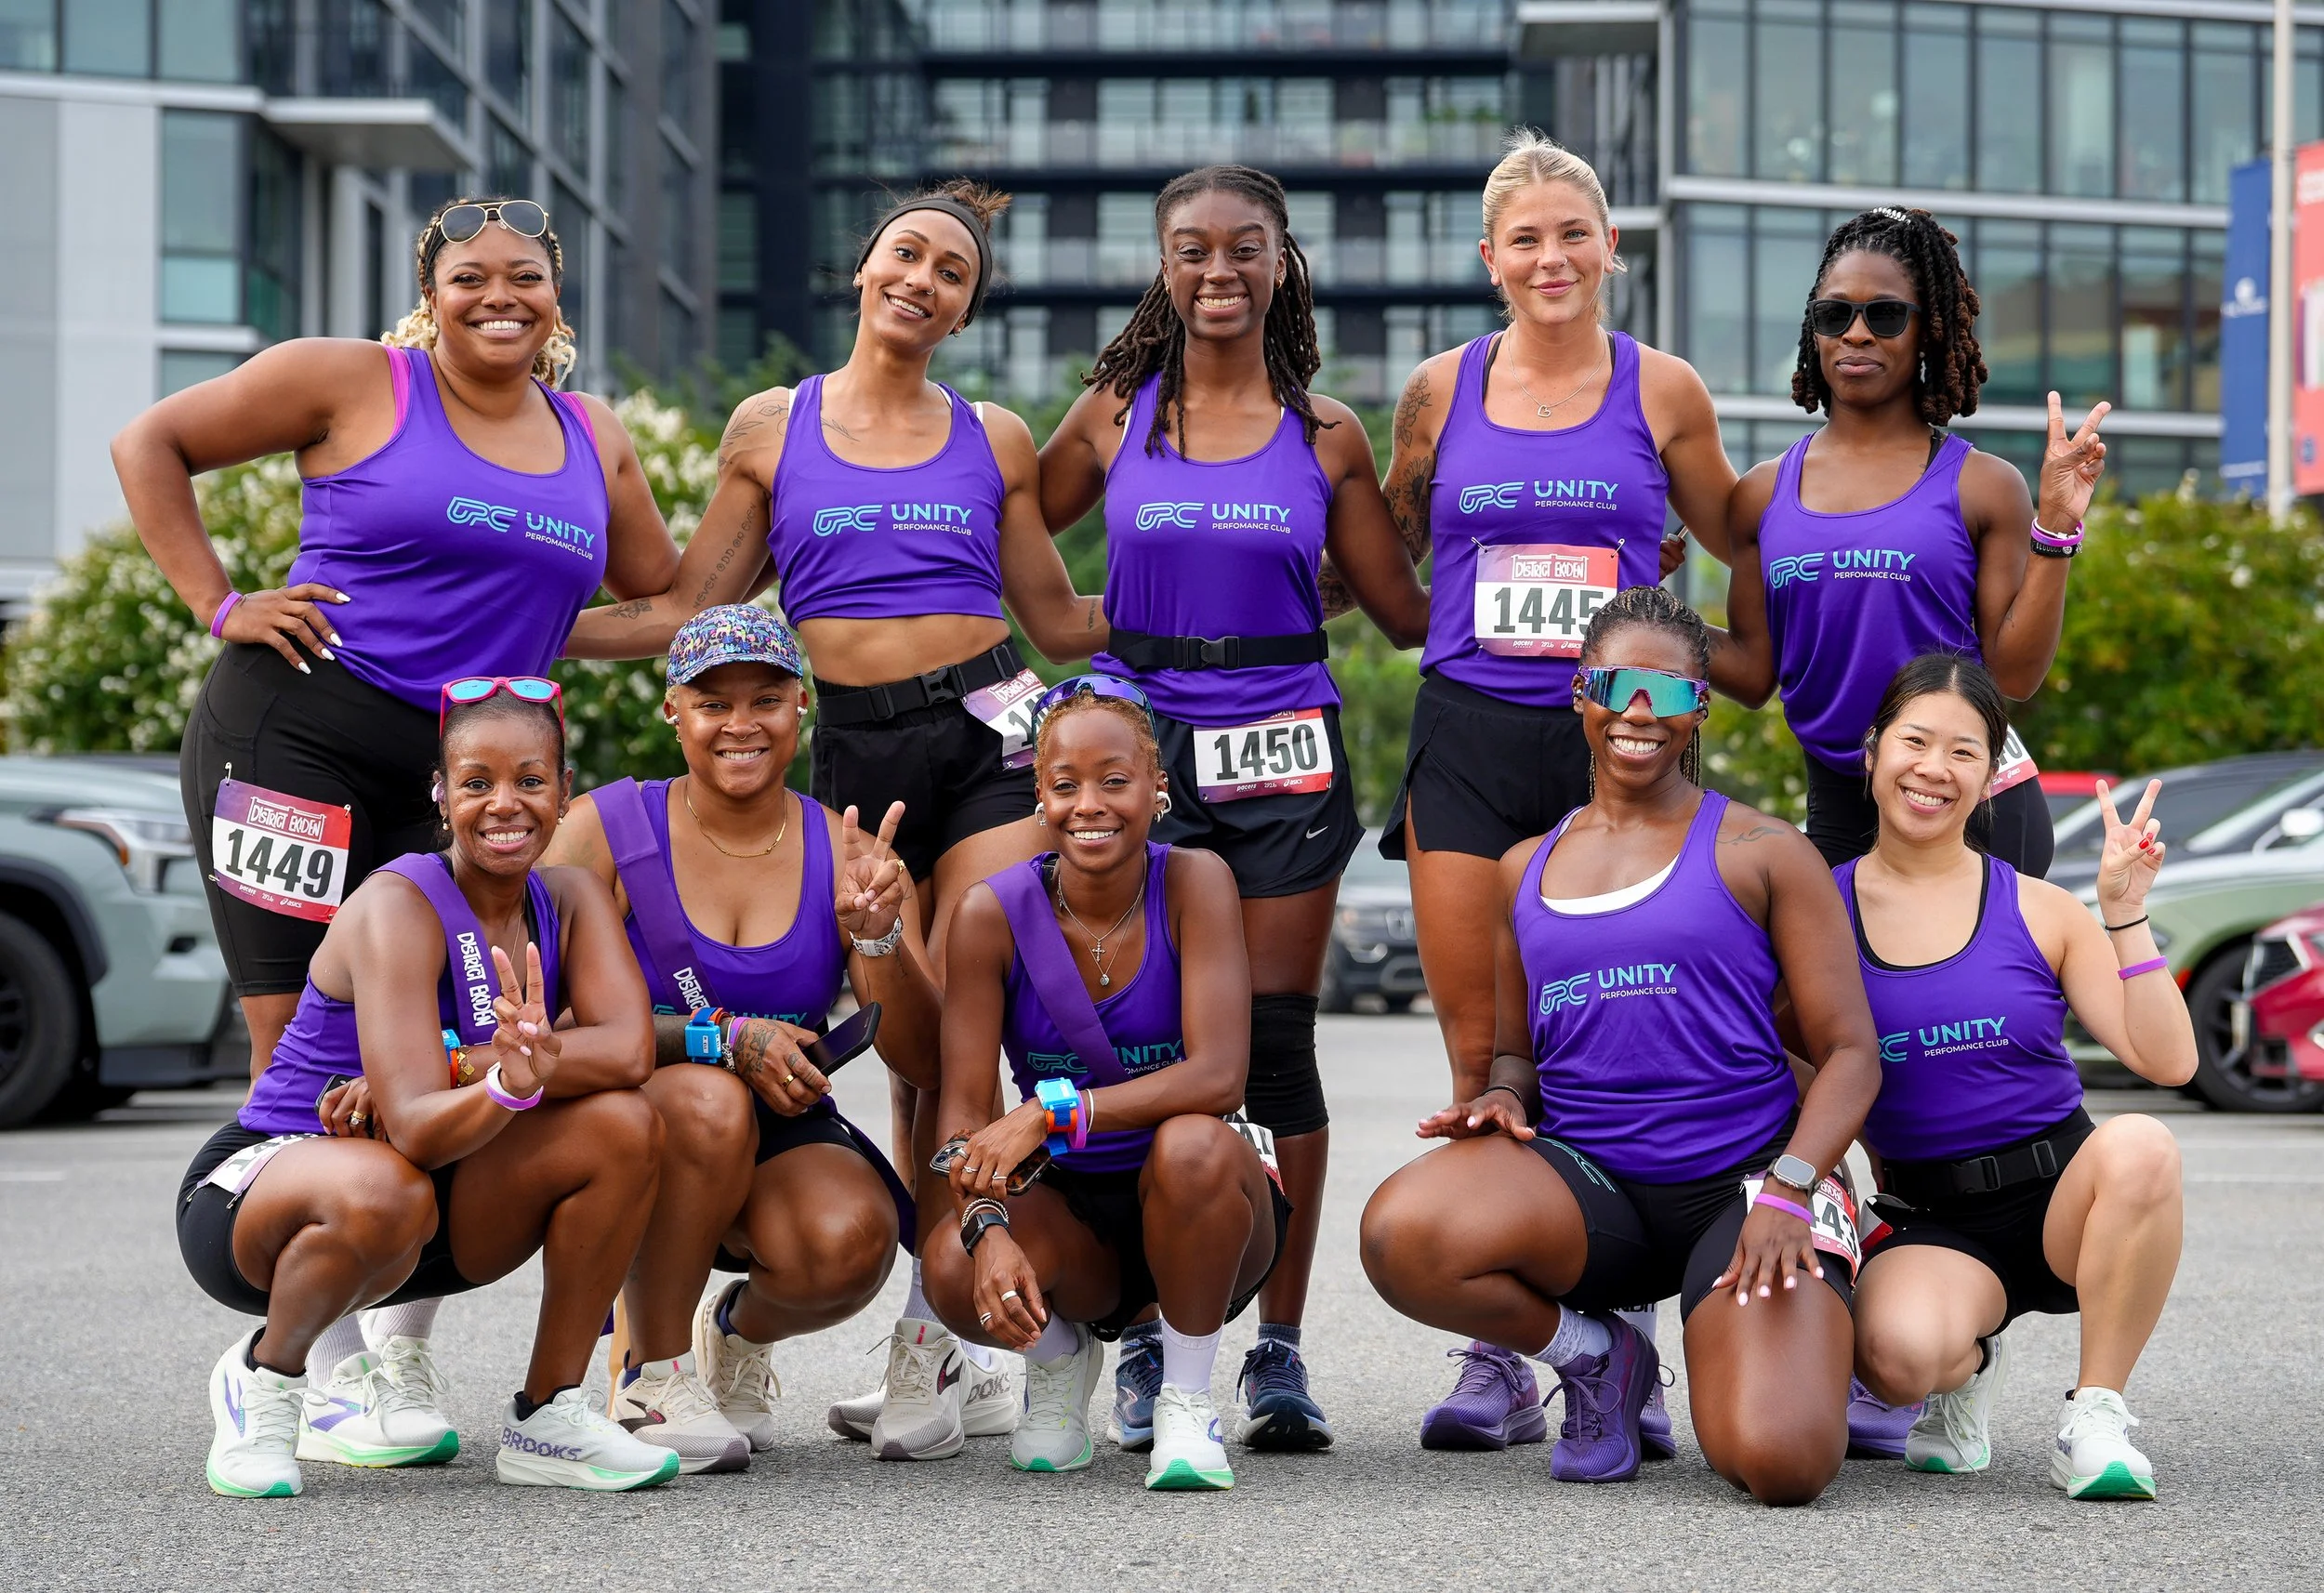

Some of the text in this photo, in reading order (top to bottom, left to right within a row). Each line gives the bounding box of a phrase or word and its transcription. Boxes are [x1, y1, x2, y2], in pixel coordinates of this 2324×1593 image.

[1534, 480, 1619, 500] UNITY
[891, 503, 972, 525] UNITY
[1211, 503, 1291, 523] UNITY
[1535, 500, 1618, 511] PERFOMANCE CLUB
[525, 511, 595, 549] UNITY
[892, 522, 972, 536] PERFOMANCE CLUB
[1212, 522, 1291, 534] PERFOMANCE CLUB
[525, 531, 594, 560] PERFOMANCE CLUB
[1515, 560, 1584, 578] DISTRICT EKIDEN
[1832, 548, 1916, 571] UNITY
[1834, 571, 1911, 582] PERFOMANCE CLUB
[1494, 586, 1604, 636] 1445
[1213, 723, 1318, 781] 1450
[250, 804, 322, 836] DISTRICT EKIDEN
[226, 827, 334, 899] 1449
[456, 931, 496, 1027] DISTRICT EKIDEN
[1597, 964, 1677, 989] UNITY
[1600, 986, 1678, 1000] PERFOMANCE CLUB
[1919, 1016, 2006, 1047] UNITY
[1113, 1038, 1182, 1064] NITY
[1924, 1041, 1984, 1058] PERFOMANCE
[1986, 1038, 2009, 1048] CLUB
[1124, 1062, 1160, 1074] OMANCE
[967, 1373, 1011, 1403] OOKS
[502, 1427, 583, 1461] BROOKS
